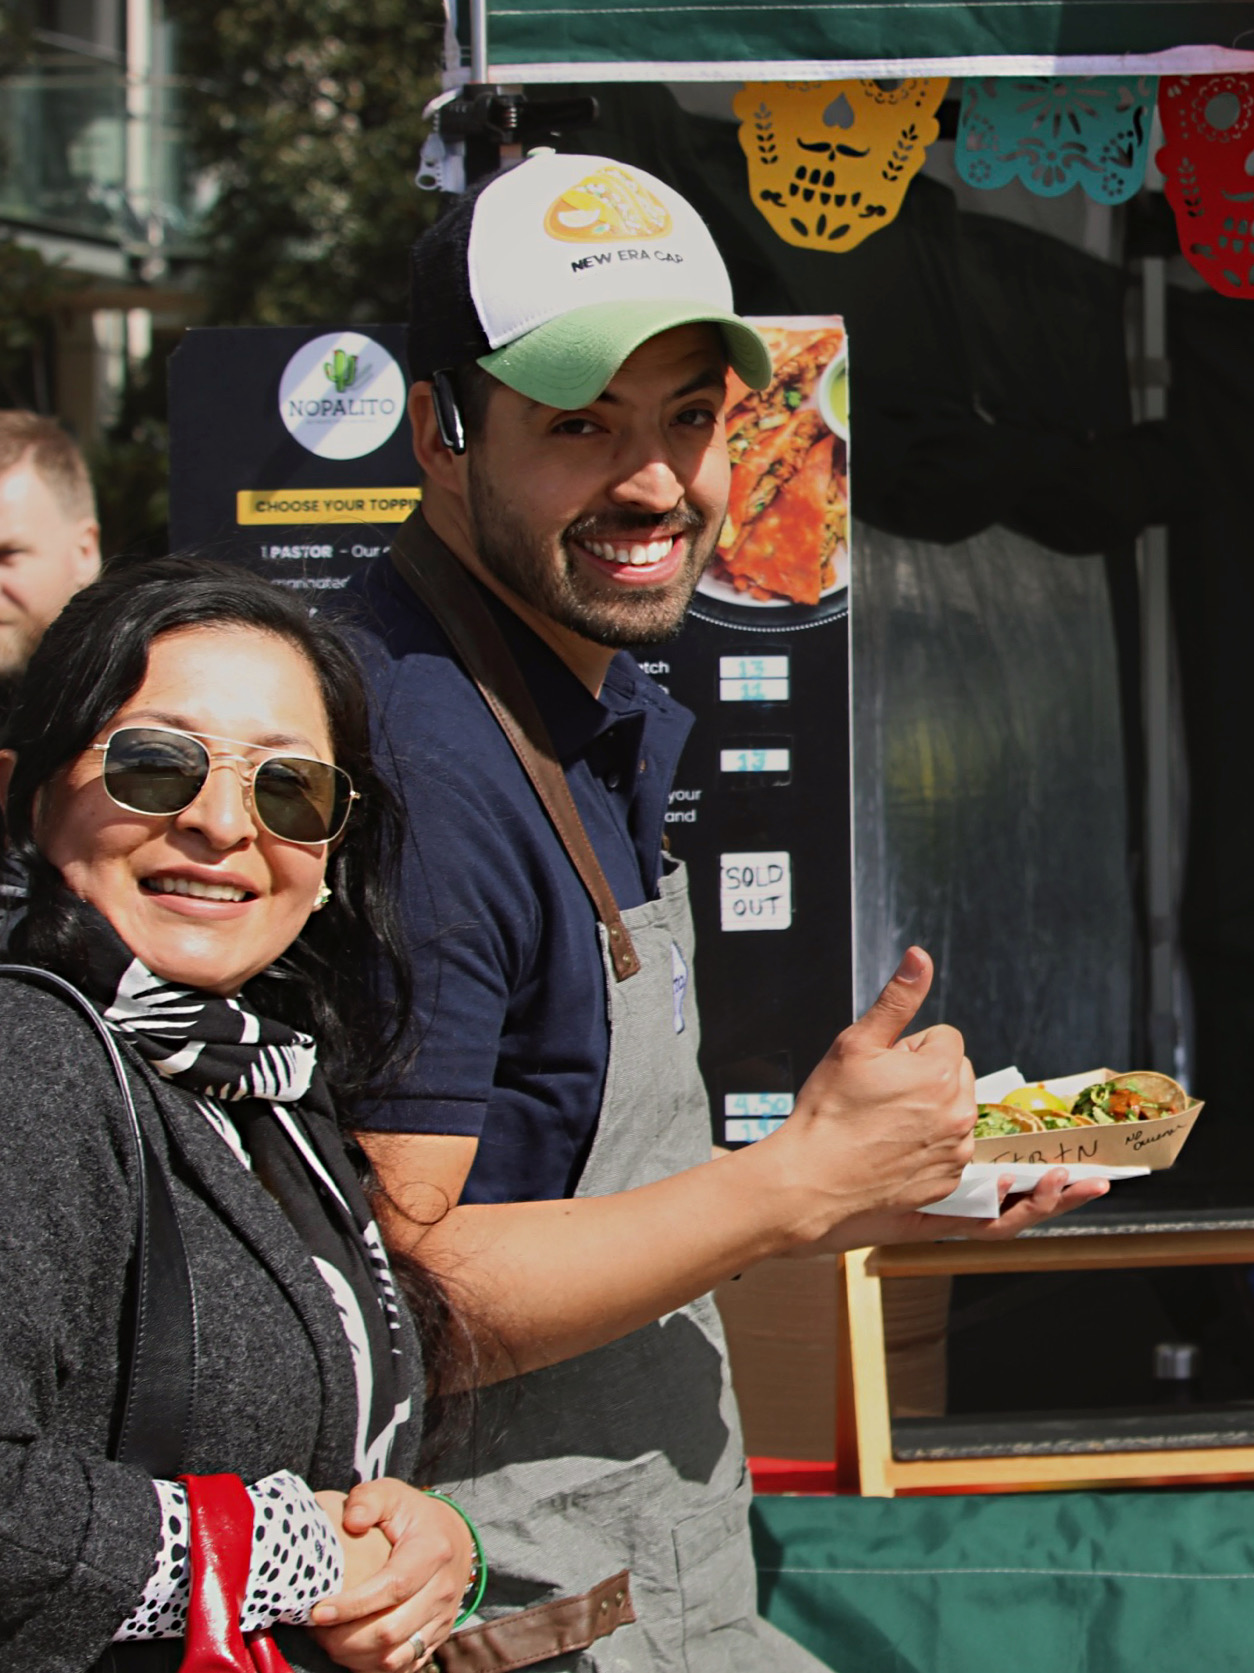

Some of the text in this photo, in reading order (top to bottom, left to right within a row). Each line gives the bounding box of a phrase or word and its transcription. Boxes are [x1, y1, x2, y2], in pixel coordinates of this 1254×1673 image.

[571, 253, 612, 273] NEW
[617, 249, 651, 261] ERA
[289, 398, 395, 417] NOPALITO
[255, 500, 319, 513] CHOOSE
[324, 499, 364, 512] YOUR
[270, 545, 334, 559] PASTOR
[351, 544, 380, 558] Our
[726, 864, 784, 890] SOLD
[733, 894, 783, 916] OUT
